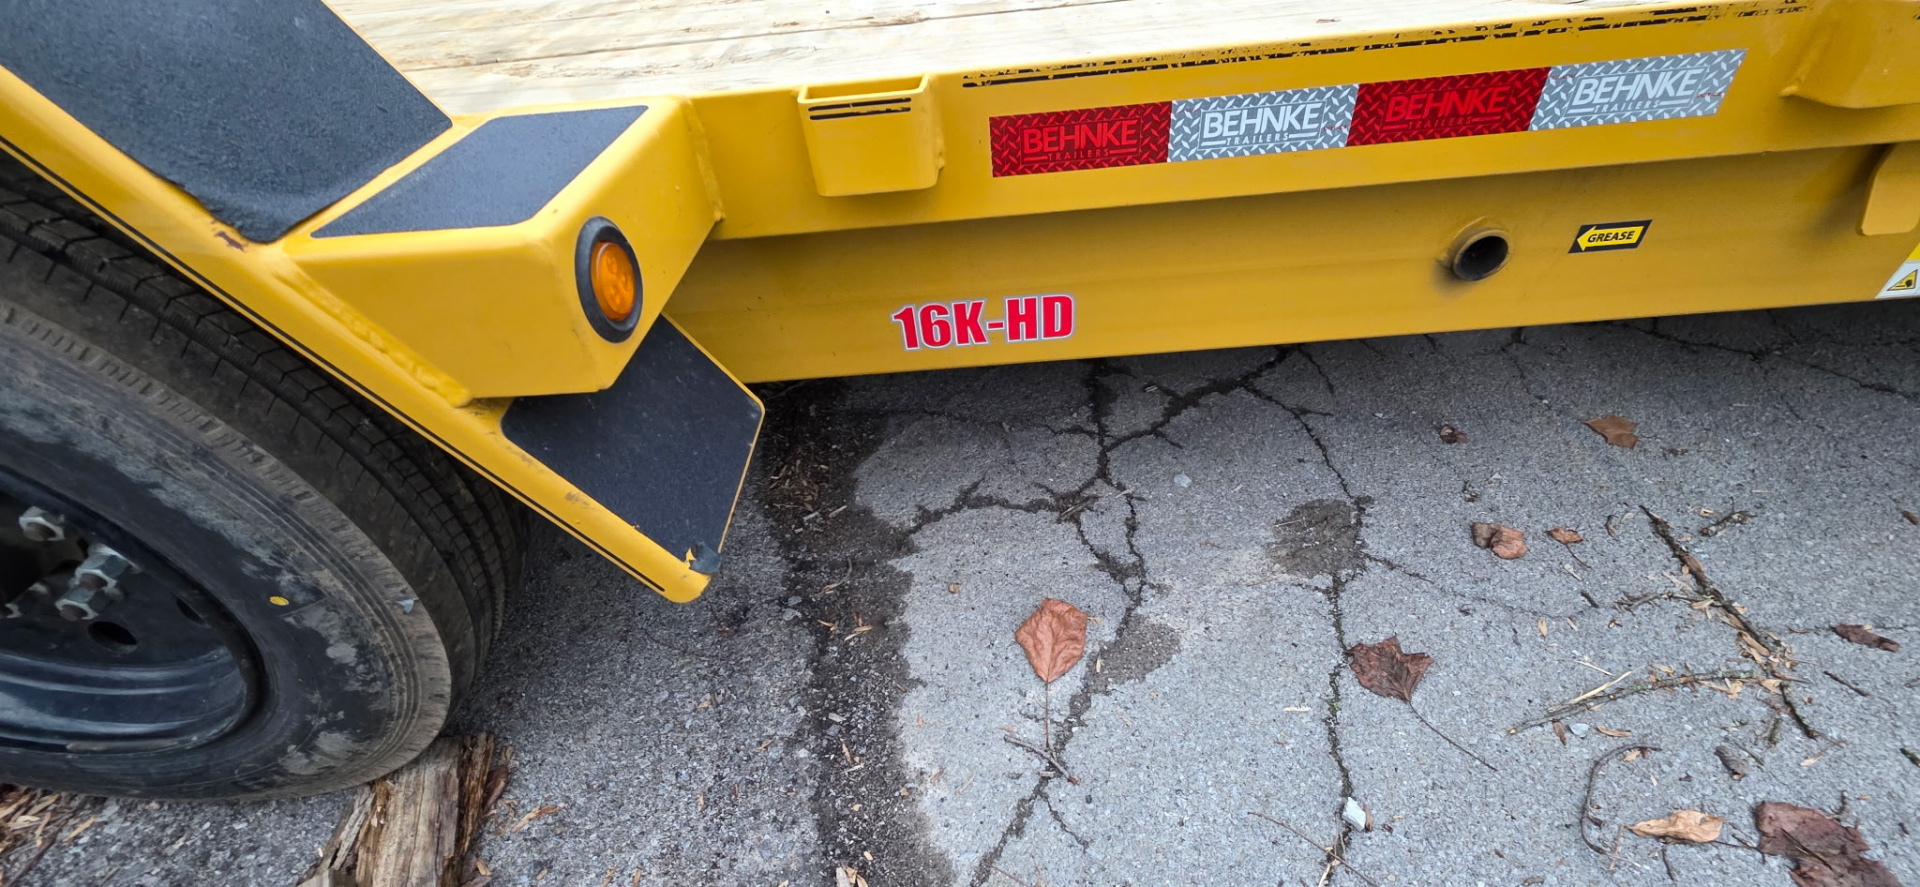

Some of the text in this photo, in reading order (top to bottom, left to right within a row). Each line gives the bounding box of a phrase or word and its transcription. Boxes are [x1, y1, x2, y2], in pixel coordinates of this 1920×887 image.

[1572, 68, 1705, 106] BEHNKE
[1385, 86, 1511, 122] BEHNKE
[1593, 100, 1660, 113] TRAILERS
[1203, 103, 1323, 138] BEHNKE
[1408, 116, 1472, 130] TRAILERS
[1023, 120, 1138, 154] BEHNKE
[1226, 132, 1289, 145] TRAILERS
[1047, 148, 1109, 161] TRAILERS
[1587, 231, 1636, 243] GREASE
[891, 294, 1076, 351] 16K-HD
